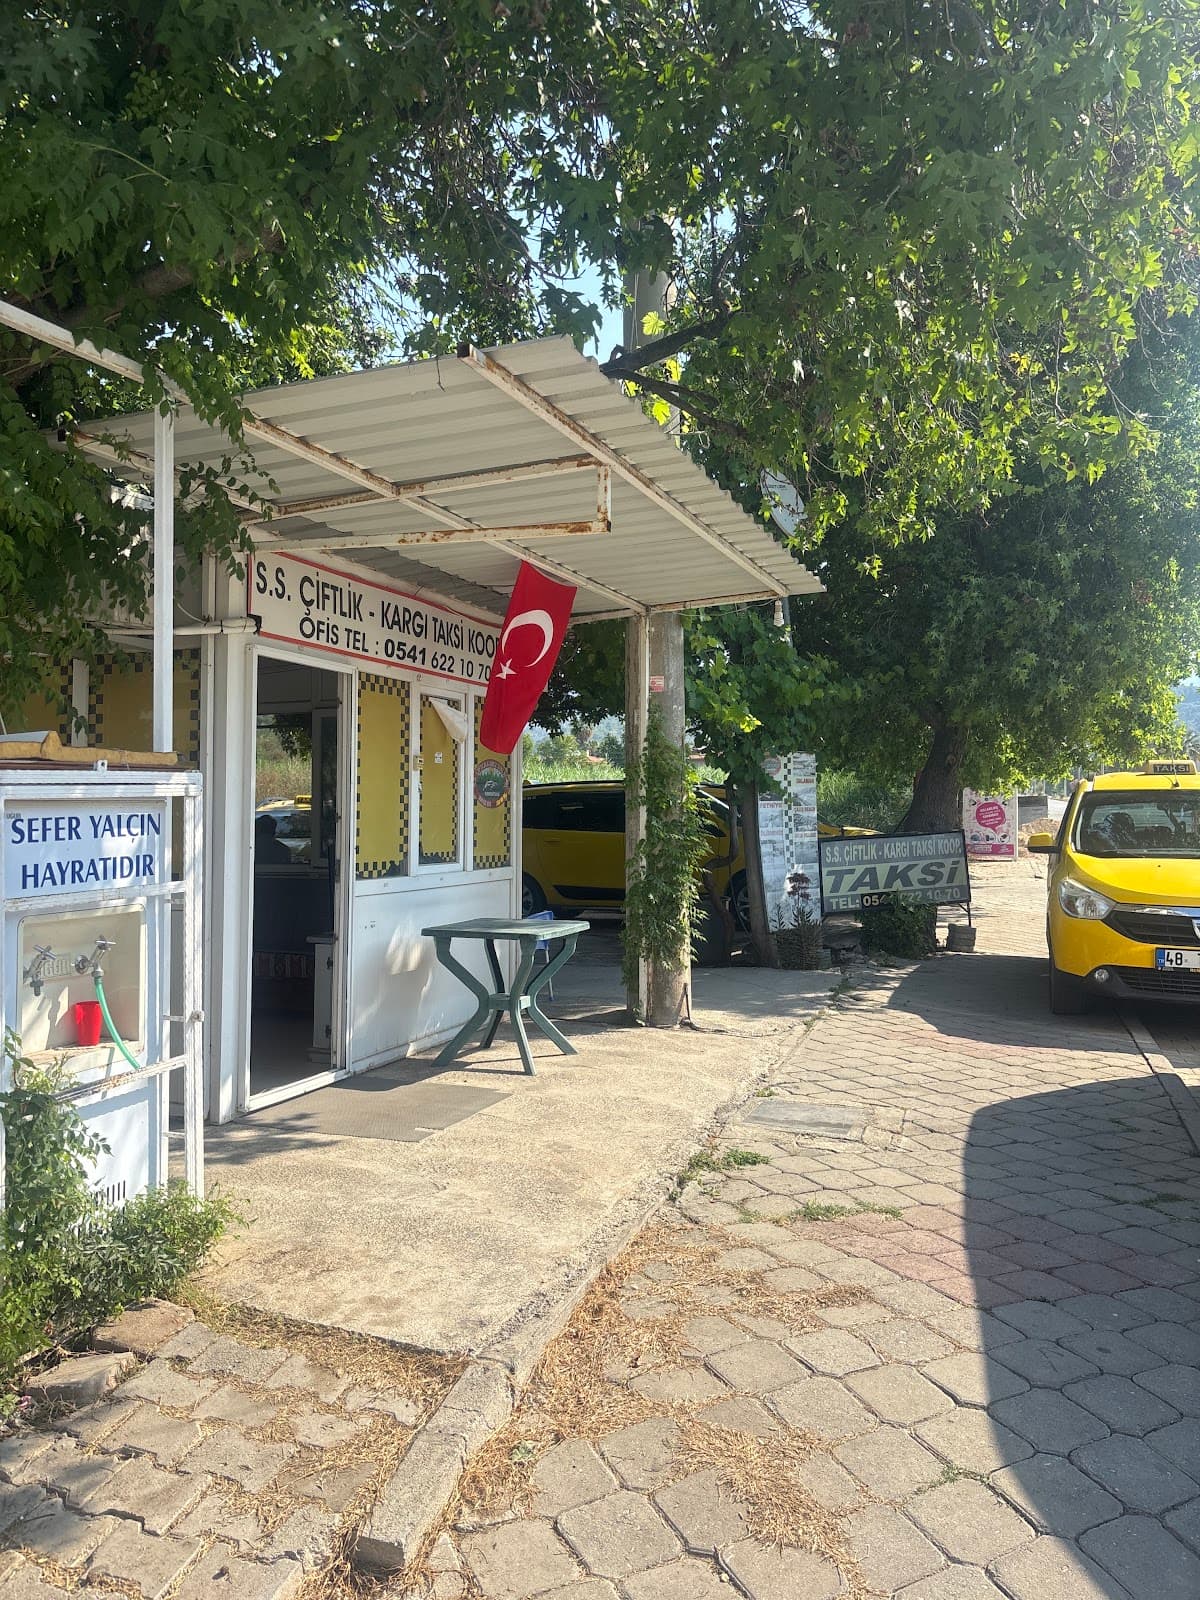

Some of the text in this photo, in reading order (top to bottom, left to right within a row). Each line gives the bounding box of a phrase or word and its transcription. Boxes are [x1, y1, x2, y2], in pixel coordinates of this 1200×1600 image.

[256, 561, 292, 602] S.S.
[299, 571, 364, 622] ÇİFTLİK
[381, 600, 428, 640] KARGI
[432, 619, 464, 651] TAKSİ
[344, 627, 369, 653] TEL
[384, 638, 427, 666] 0541
[431, 651, 455, 673] 622
[460, 658, 474, 678] 10
[478, 663, 492, 682] 70
[11, 813, 161, 844] SEFER YALÇIN
[825, 847, 842, 863] S.S.
[843, 840, 877, 865] ÇİFTLİK
[883, 842, 910, 859] KARGI
[936, 838, 962, 855] KOOP.
[21, 854, 155, 890] HAYRATIDIR
[829, 896, 860, 910] TEL:
[944, 888, 960, 899] 70
[1166, 951, 1183, 966] 48
